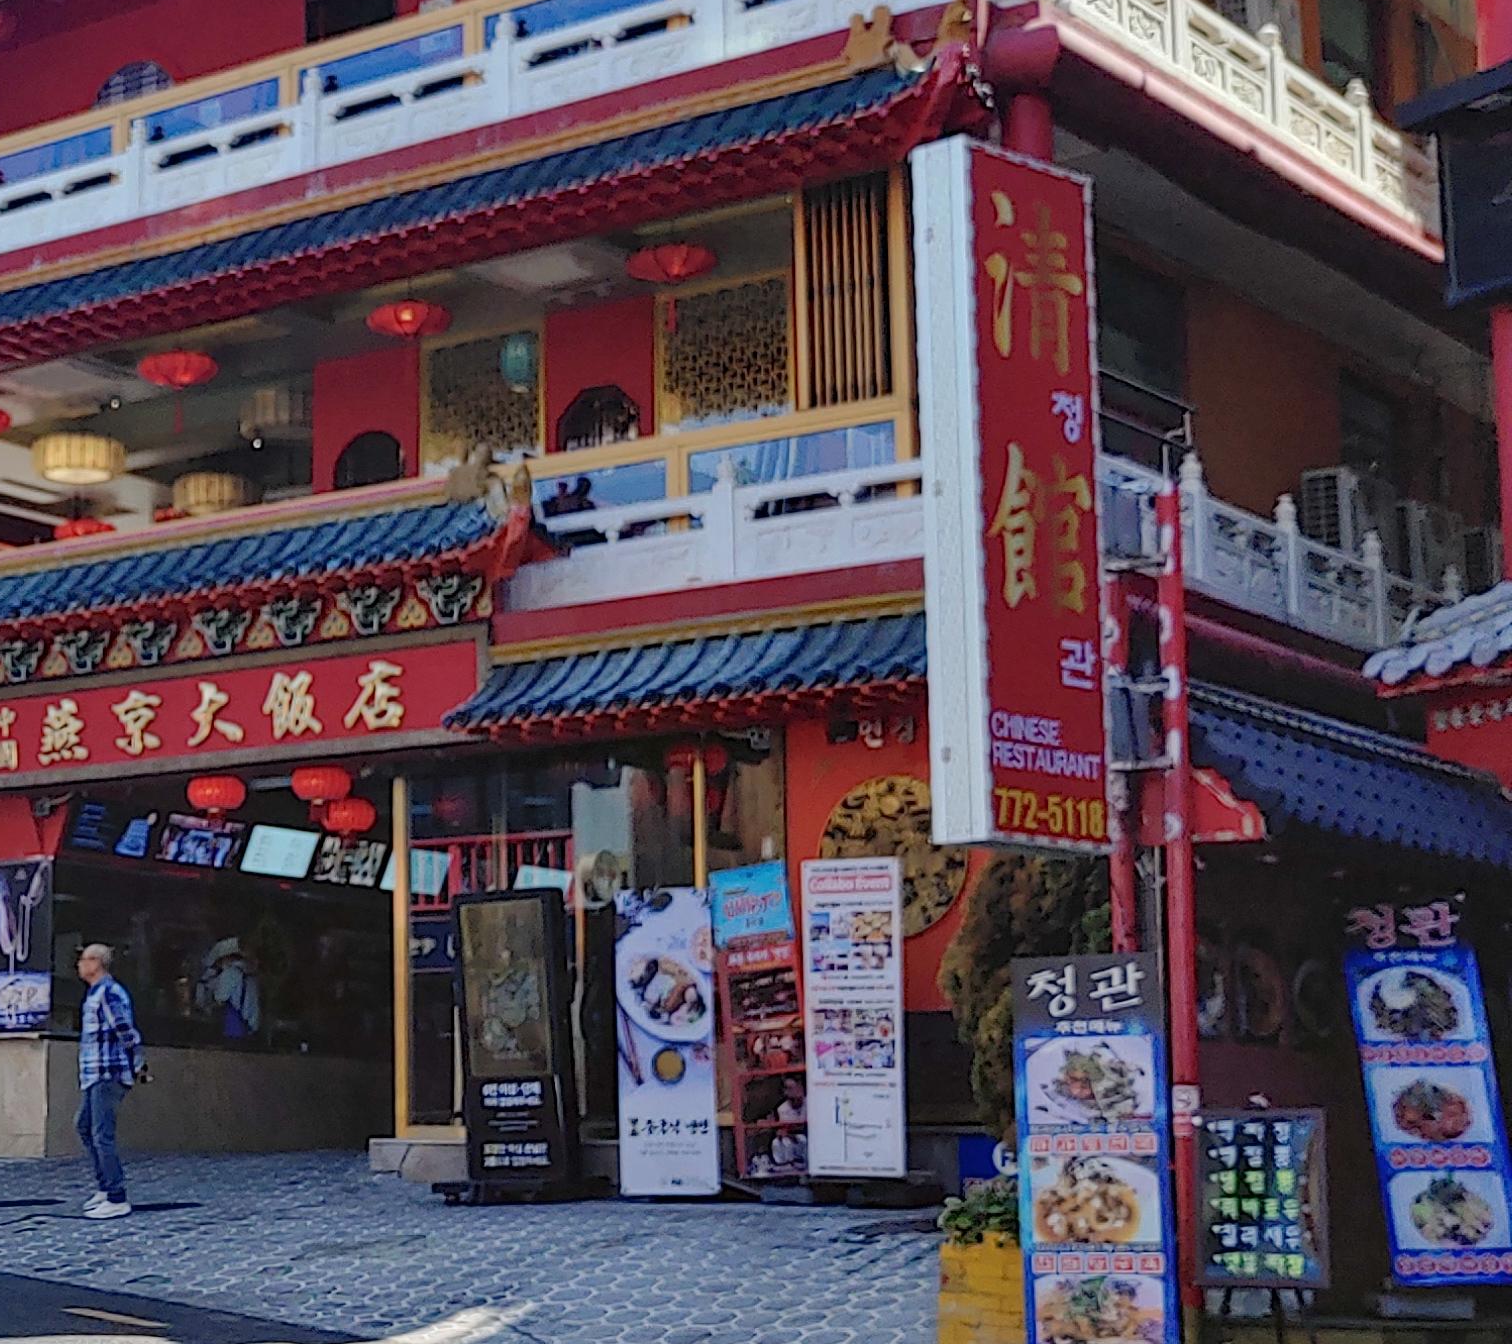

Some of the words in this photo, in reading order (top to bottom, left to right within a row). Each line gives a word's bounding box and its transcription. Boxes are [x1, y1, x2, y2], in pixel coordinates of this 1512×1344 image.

[37, 660, 406, 766] 燕京大飯店
[990, 711, 1062, 746] CHINESE
[992, 740, 1101, 781] RESTAURANT
[993, 787, 1106, 839] 772-5118
[1025, 961, 1146, 1018] 정관
